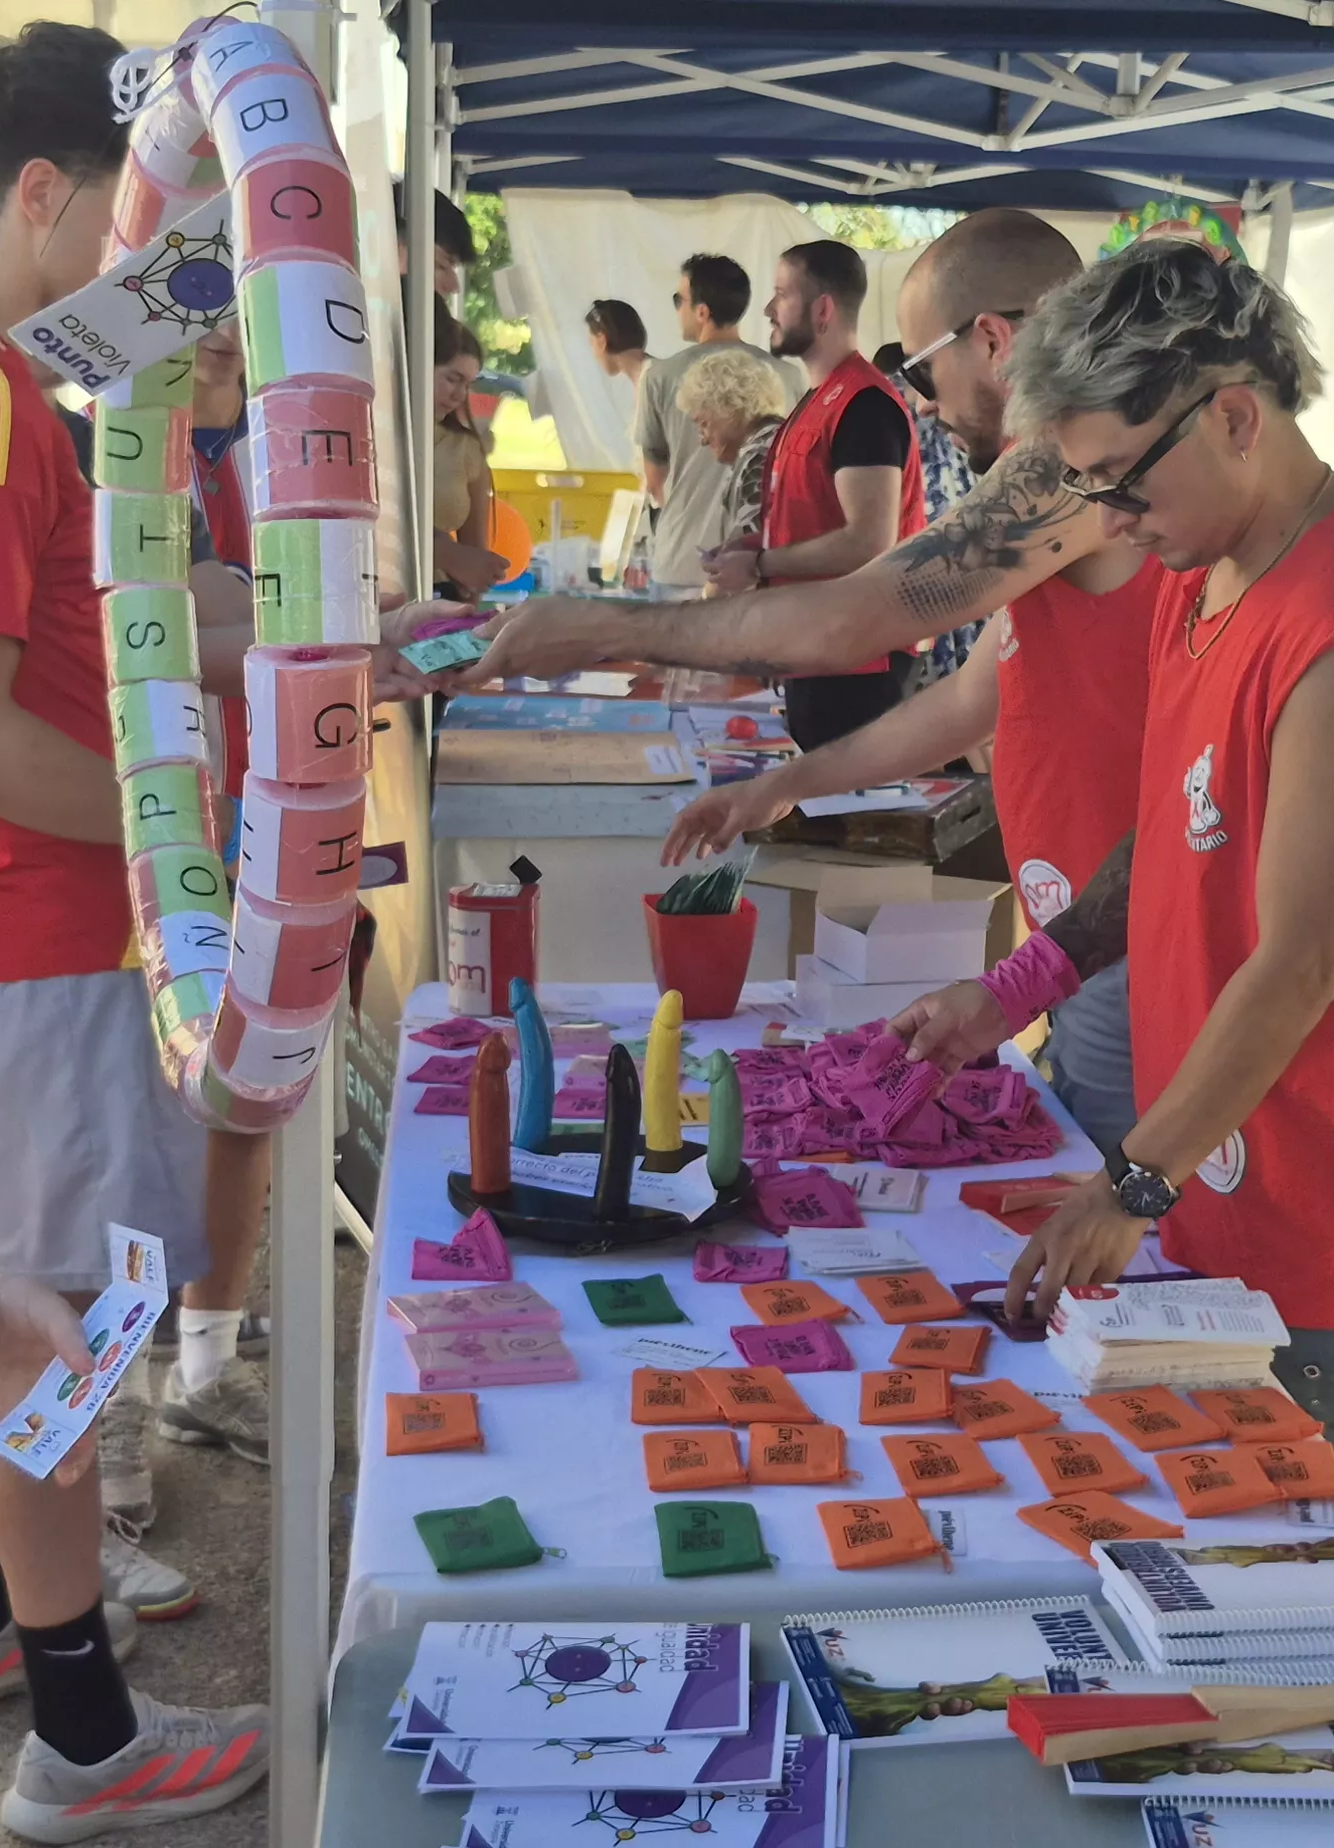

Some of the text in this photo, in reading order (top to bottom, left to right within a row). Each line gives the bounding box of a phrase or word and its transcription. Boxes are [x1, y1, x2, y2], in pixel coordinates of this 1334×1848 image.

[210, 40, 254, 72] A
[239, 98, 289, 132] B
[270, 185, 322, 219] C
[325, 298, 367, 344] D
[33, 327, 111, 389] Punto
[58, 313, 131, 376] Violeta
[106, 425, 144, 462] U
[301, 429, 354, 467] E
[125, 620, 166, 650] S
[314, 702, 362, 749] G
[138, 792, 177, 821] P
[316, 830, 358, 876] H
[179, 865, 218, 897] O
[182, 924, 231, 951] Ñ
[272, 1046, 317, 1065] J
[100, 1311, 156, 1390] BIENVENIDA
